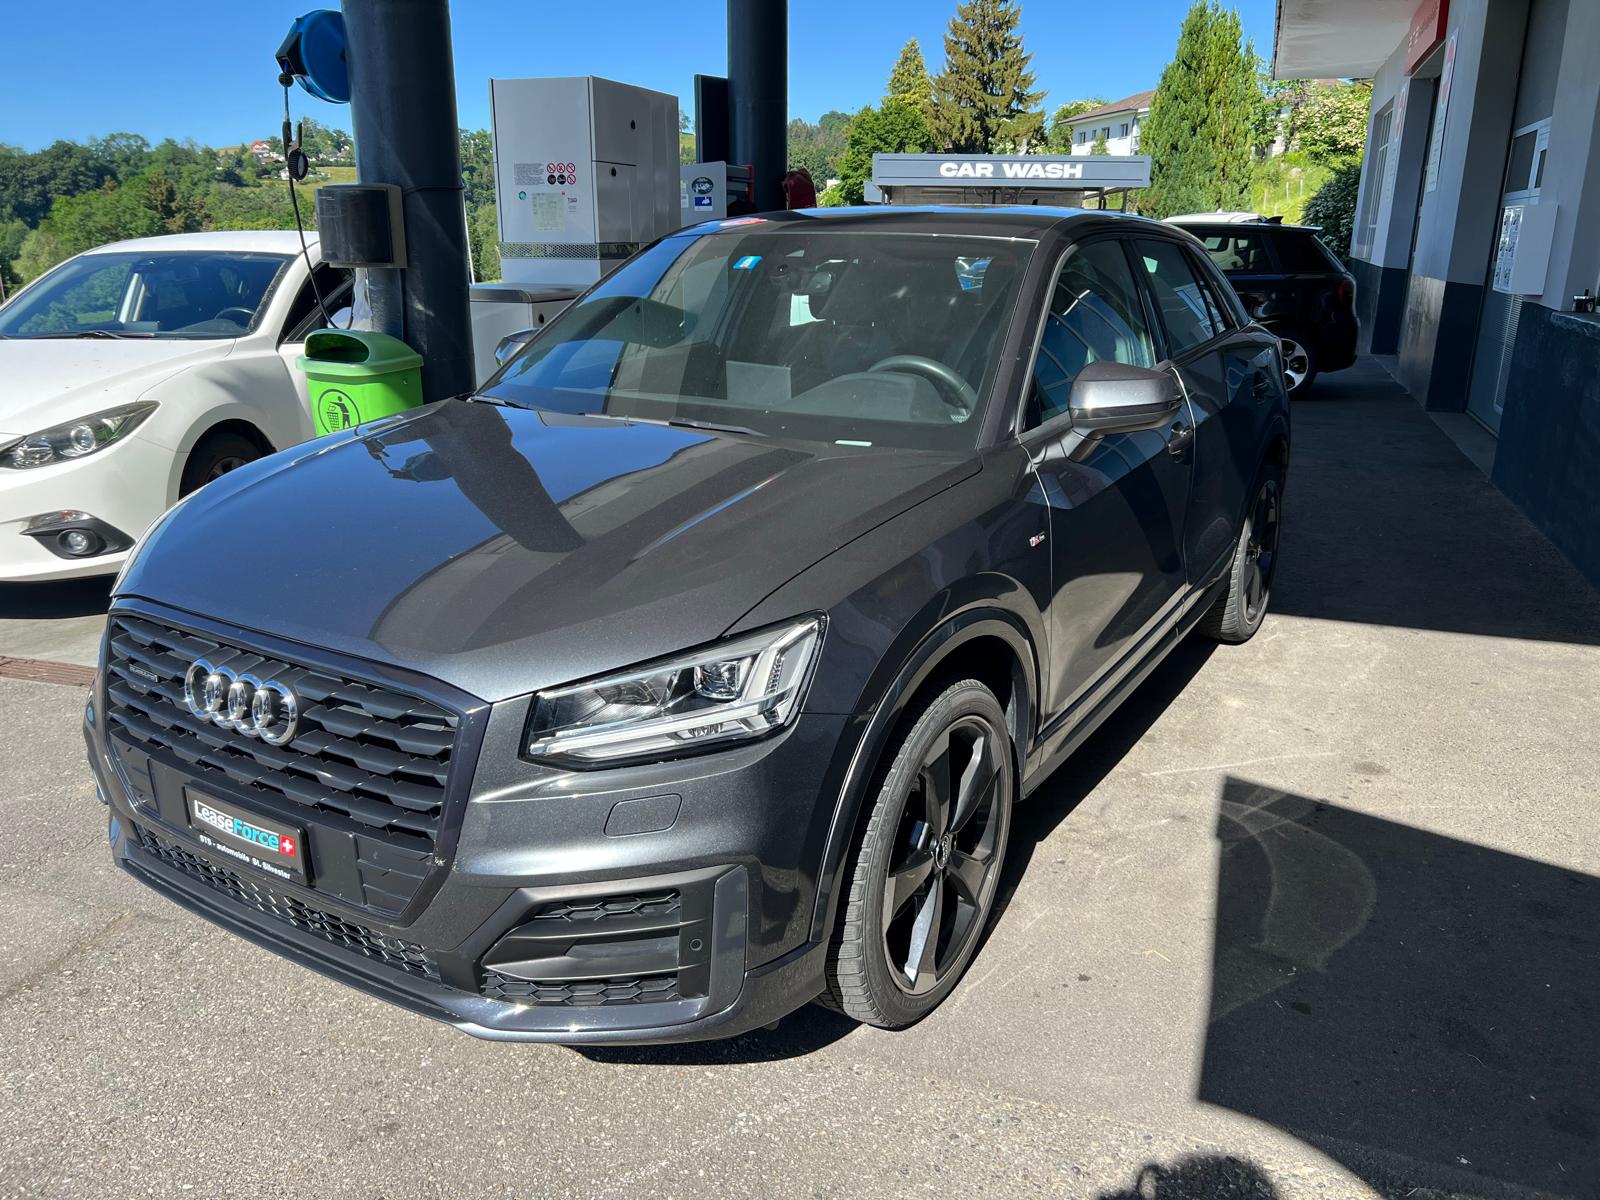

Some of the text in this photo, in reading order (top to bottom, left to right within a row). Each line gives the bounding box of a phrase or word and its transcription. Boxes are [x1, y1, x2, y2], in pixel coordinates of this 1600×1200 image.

[940, 162, 1083, 179] CAR WASH
[194, 799, 280, 850] LeaseForce
[216, 842, 250, 863] automobile
